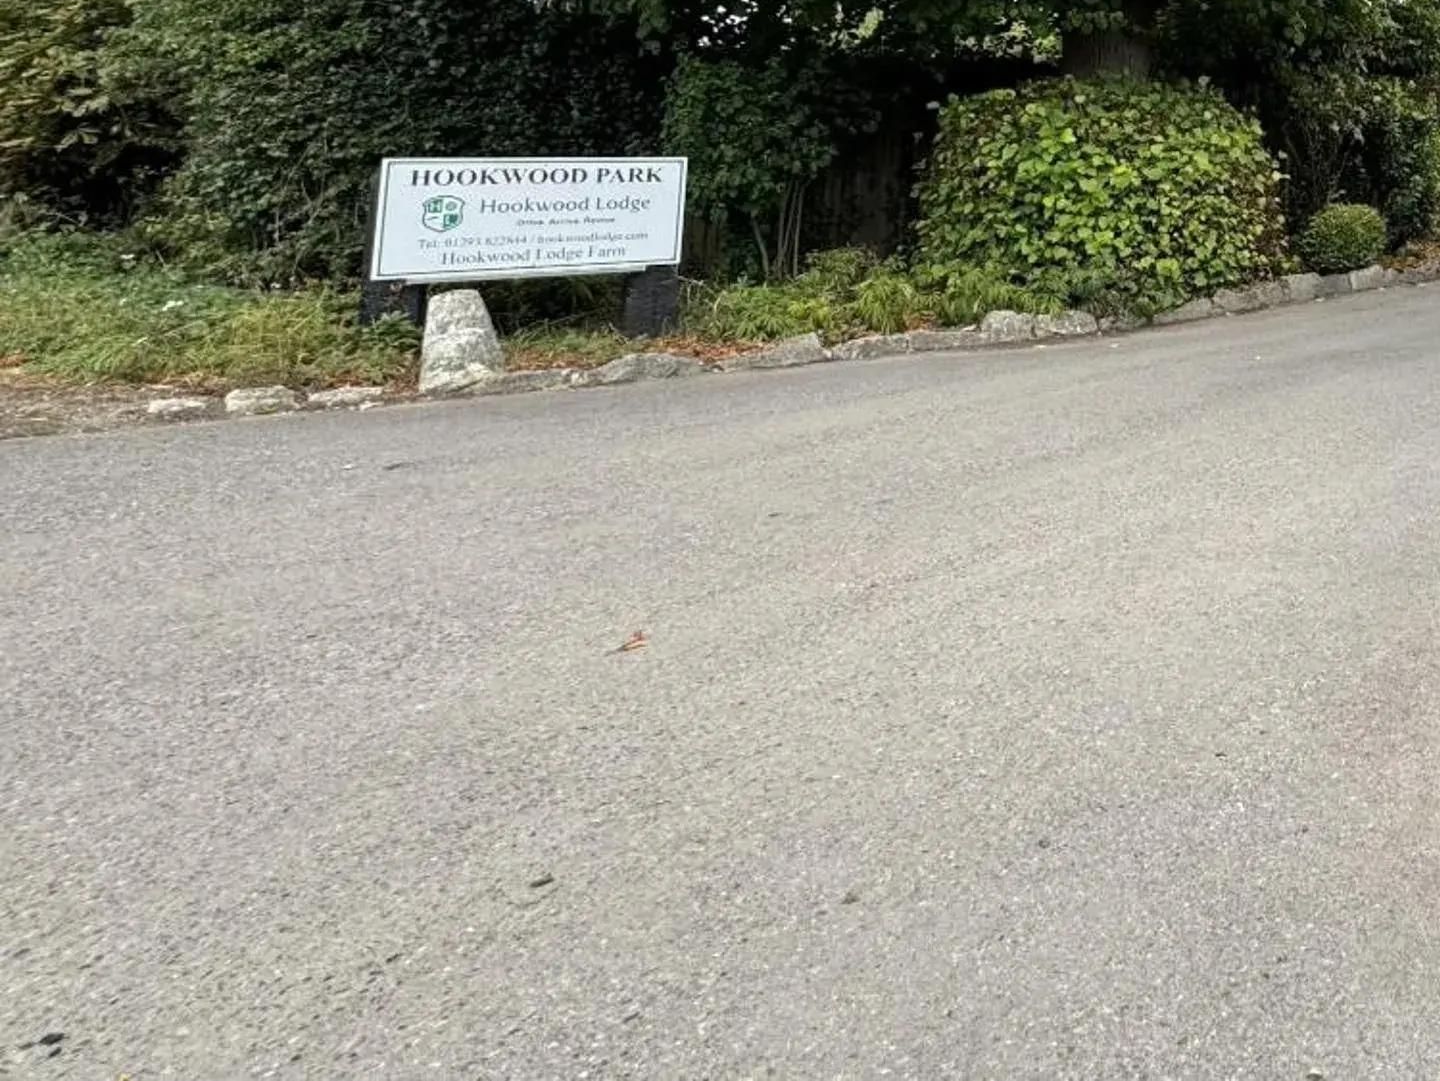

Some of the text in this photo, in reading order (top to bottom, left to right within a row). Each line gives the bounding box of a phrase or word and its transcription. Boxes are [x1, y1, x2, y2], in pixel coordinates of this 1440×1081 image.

[411, 167, 662, 186] HOOKWOOD PARK
[480, 195, 651, 213] Hookwood Lodge
[442, 249, 531, 265] Hookwood
